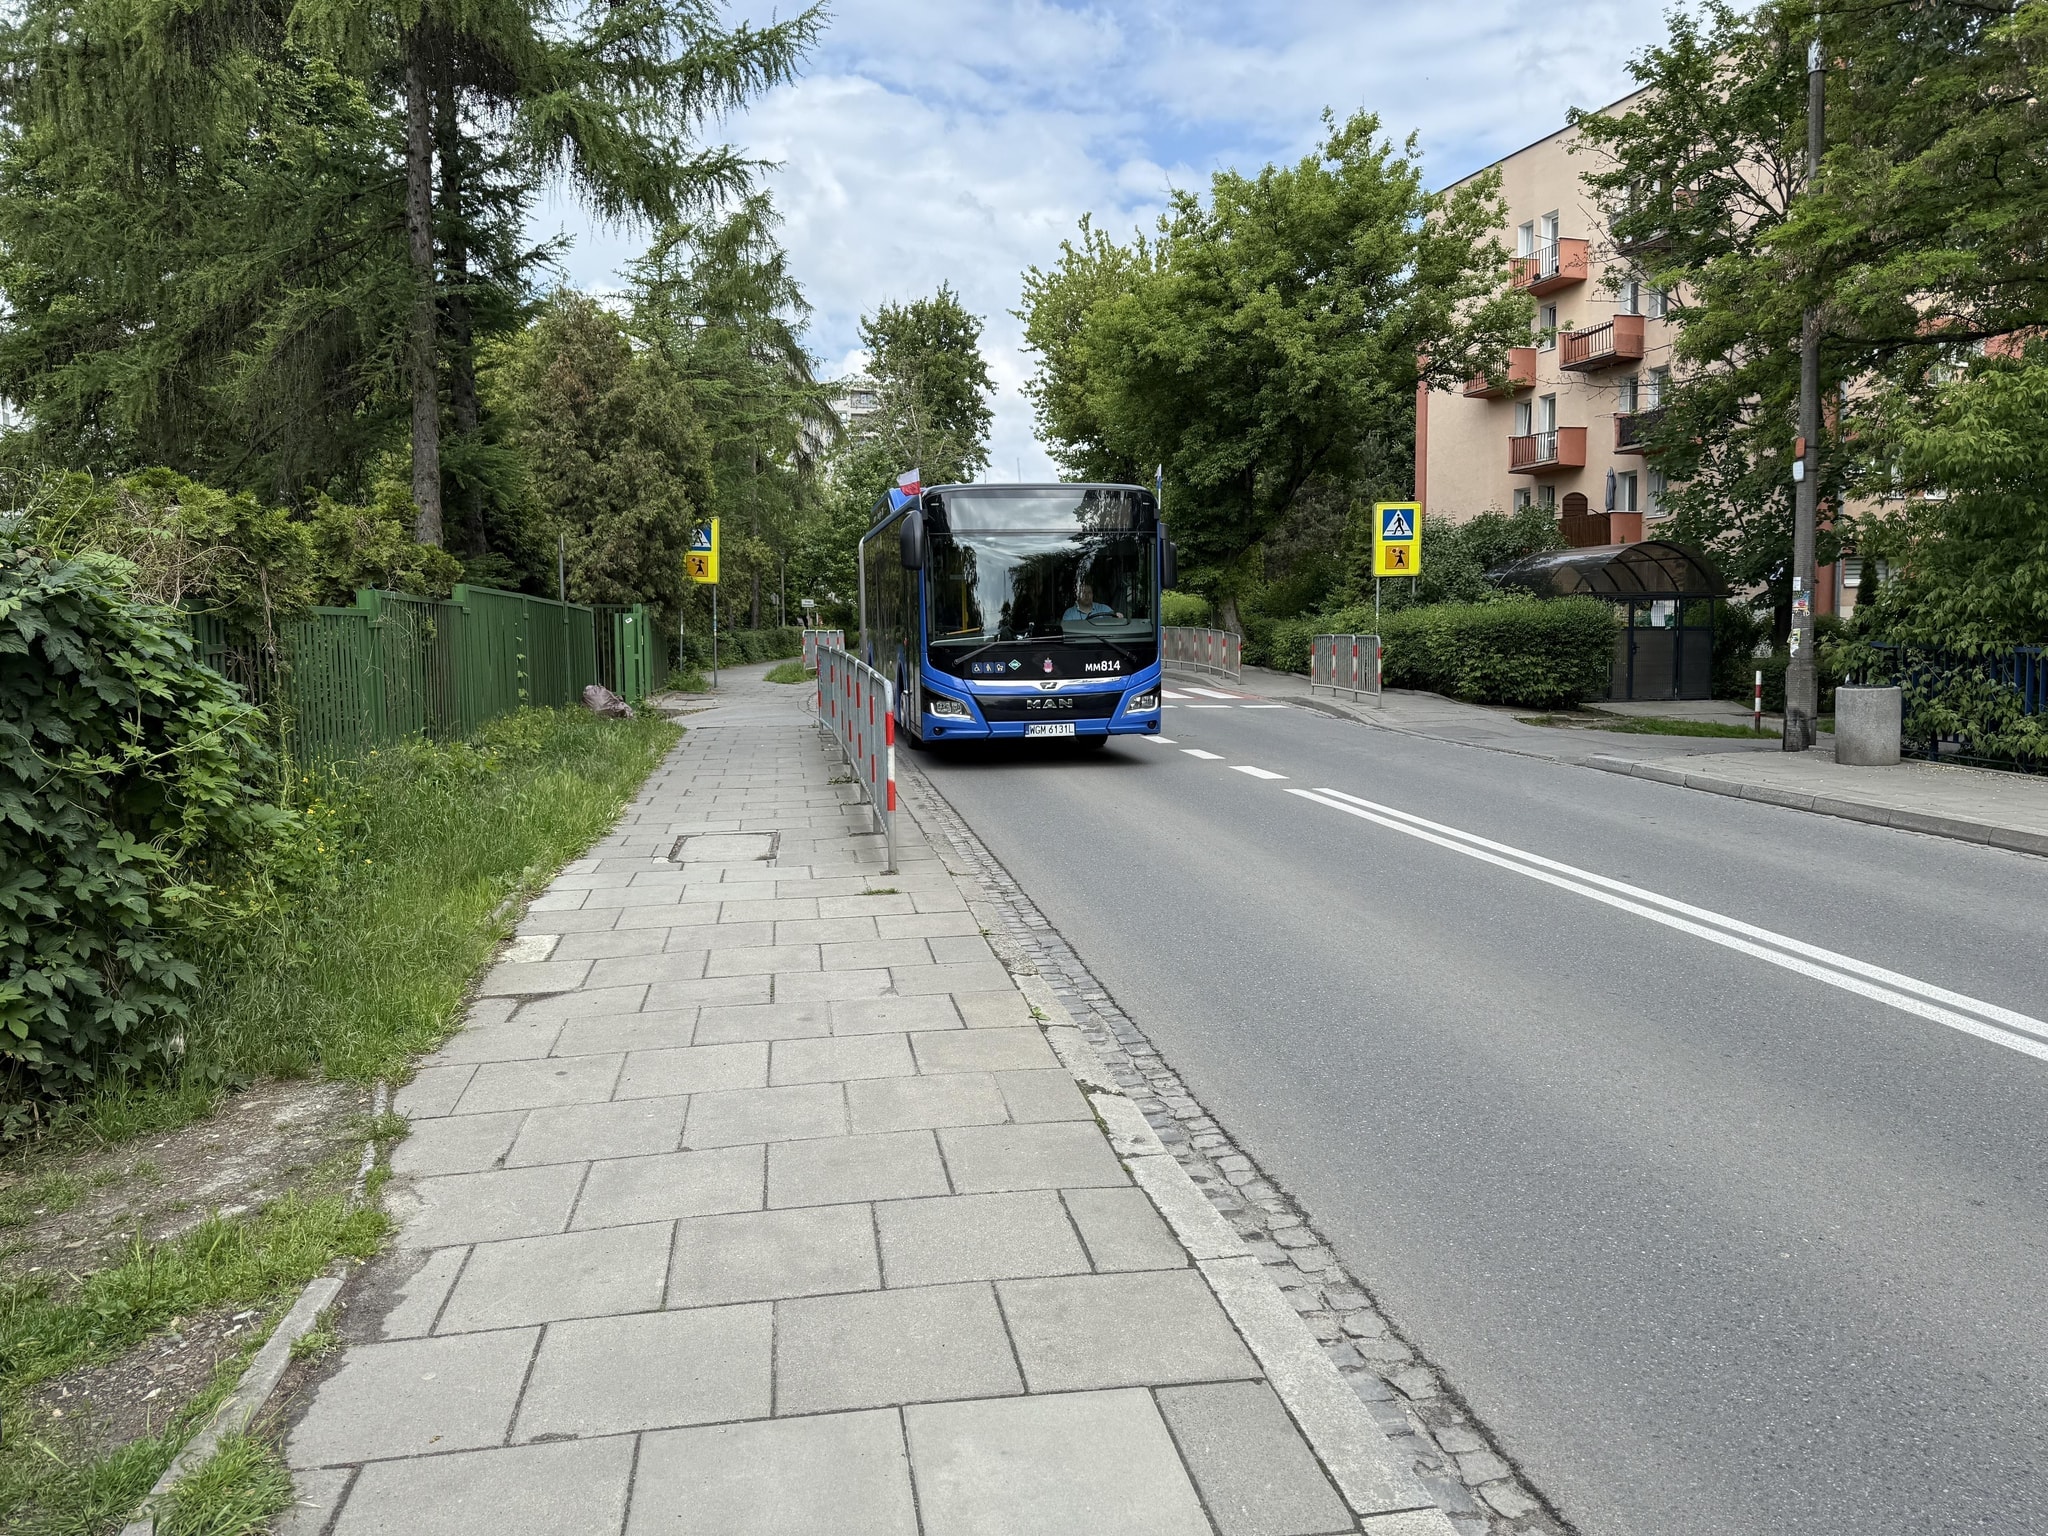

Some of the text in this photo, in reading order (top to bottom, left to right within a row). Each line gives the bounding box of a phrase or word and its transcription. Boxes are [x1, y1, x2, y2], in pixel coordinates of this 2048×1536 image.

[1085, 660, 1120, 671] MM814
[1026, 698, 1073, 709] MAN
[1029, 724, 1074, 735] WGM 6131L
